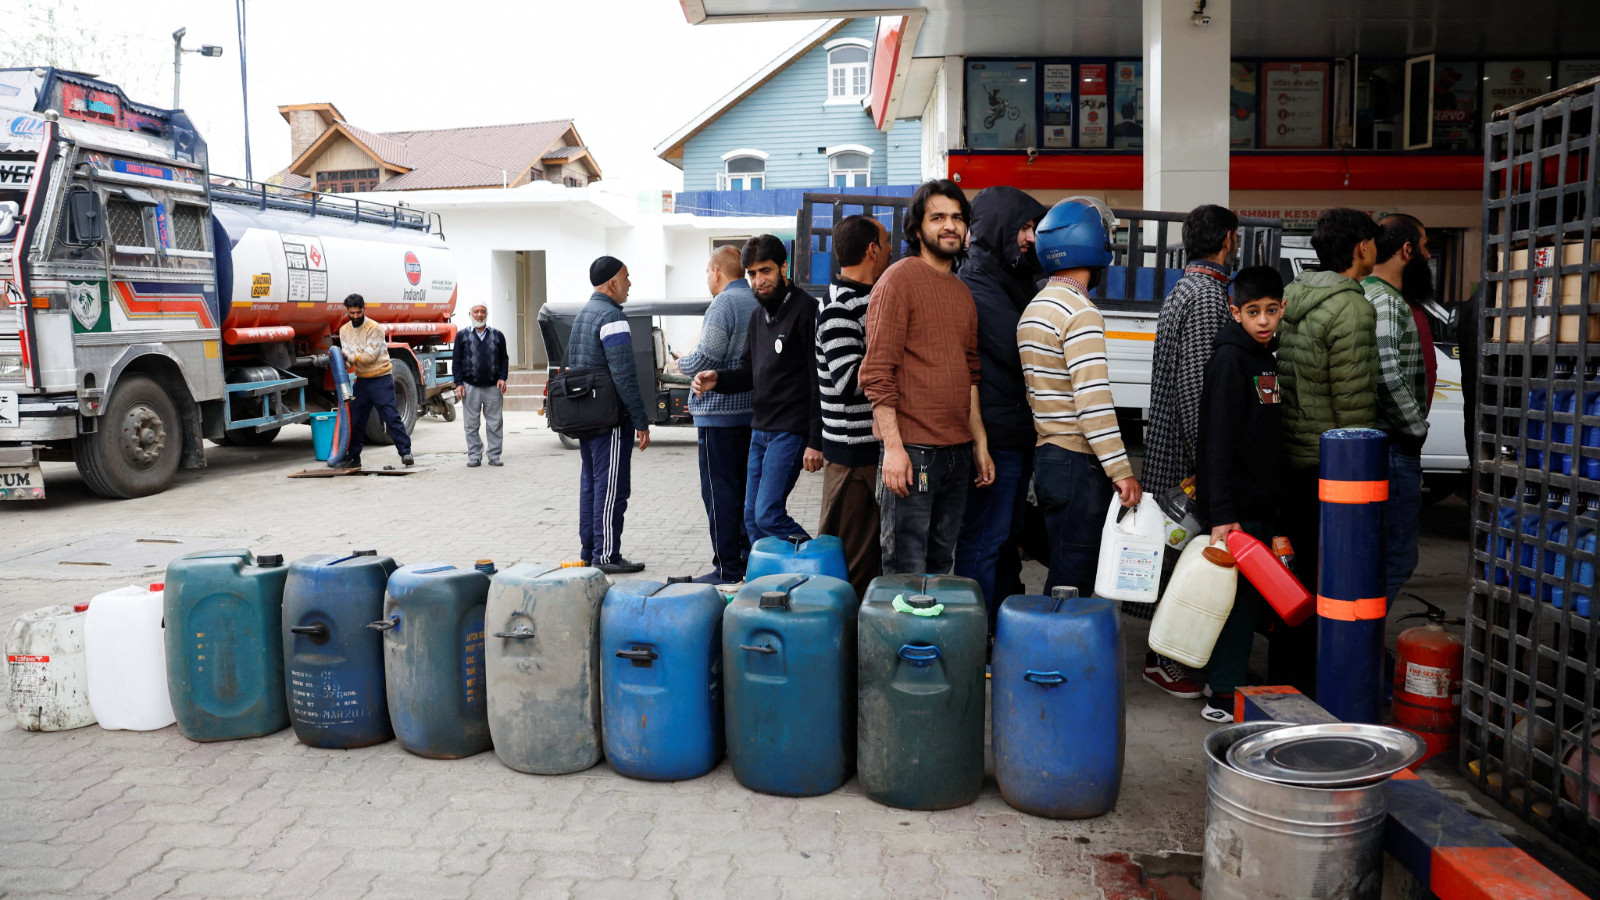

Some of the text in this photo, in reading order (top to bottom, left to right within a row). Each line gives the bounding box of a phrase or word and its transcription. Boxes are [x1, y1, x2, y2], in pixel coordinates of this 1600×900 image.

[1232, 209, 1281, 218] ASHMIR
[1284, 210, 1318, 218] KESS
[0, 473, 31, 486] UM
